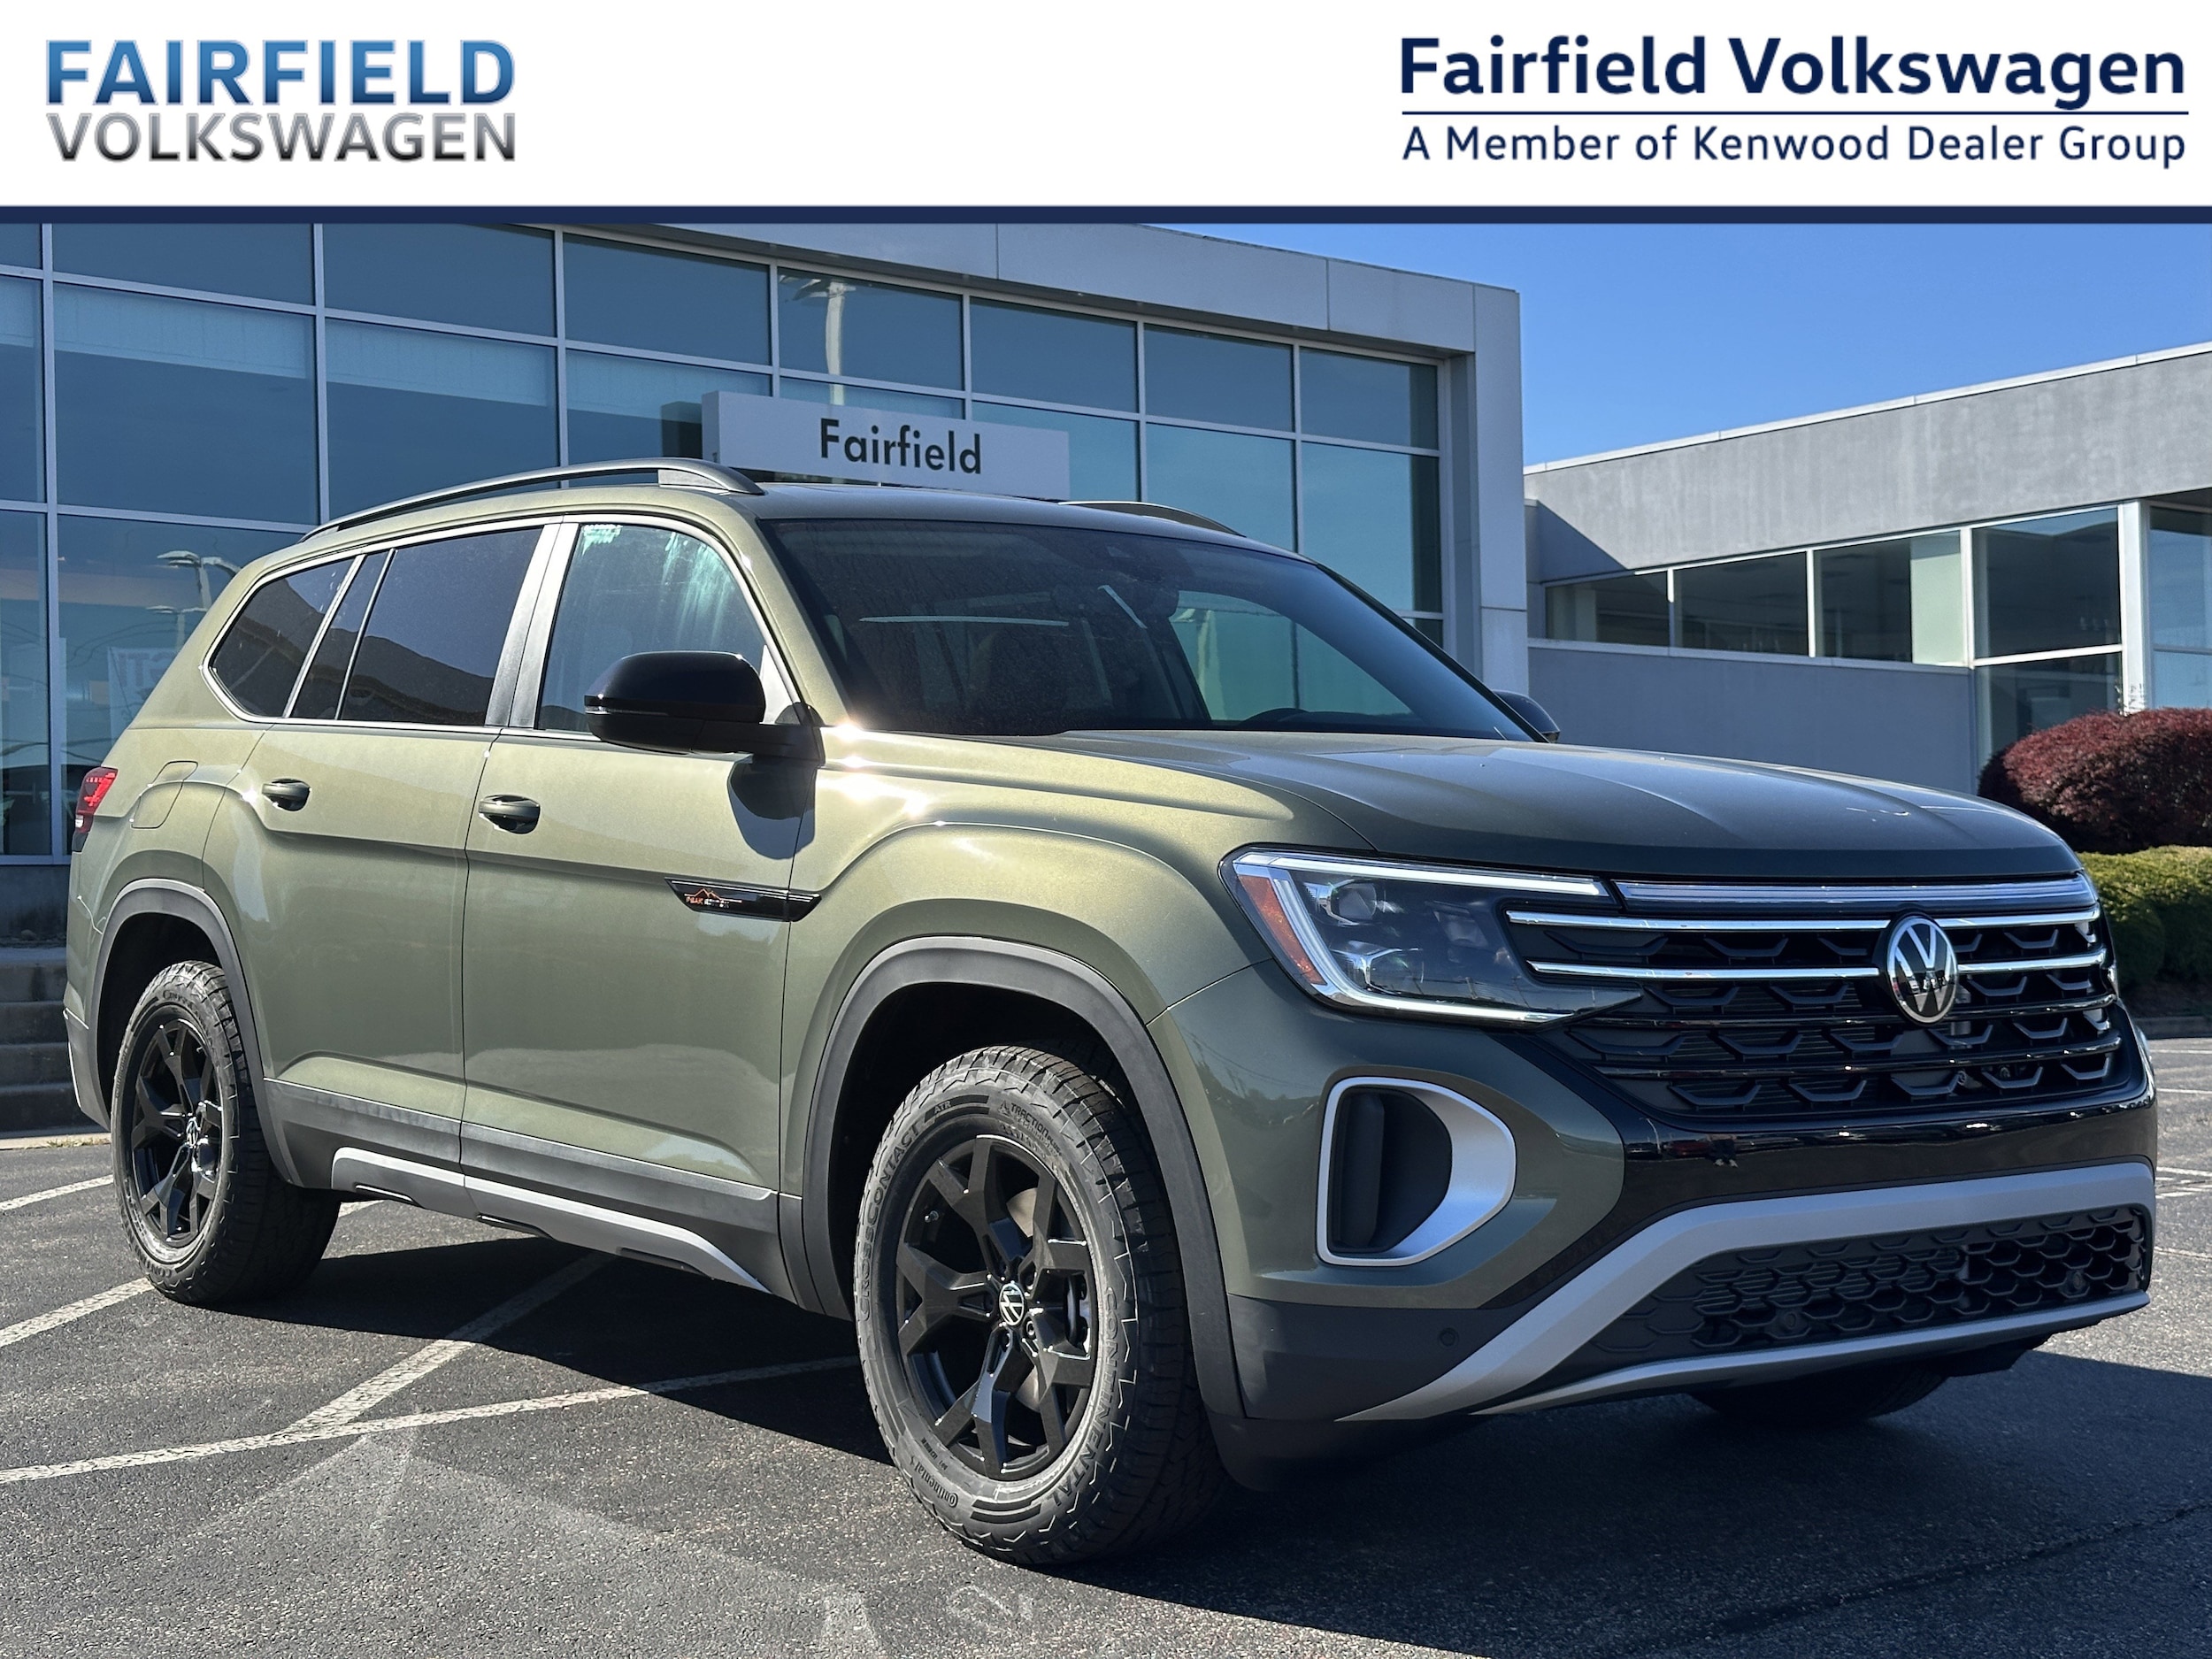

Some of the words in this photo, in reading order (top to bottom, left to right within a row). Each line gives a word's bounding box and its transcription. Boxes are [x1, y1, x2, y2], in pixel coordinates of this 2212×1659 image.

[820, 418, 981, 474] Fairfield
[934, 1101, 951, 1114] ATR
[1050, 1286, 1119, 1507] CONTINENTAL
[914, 1461, 959, 1508] Continental
